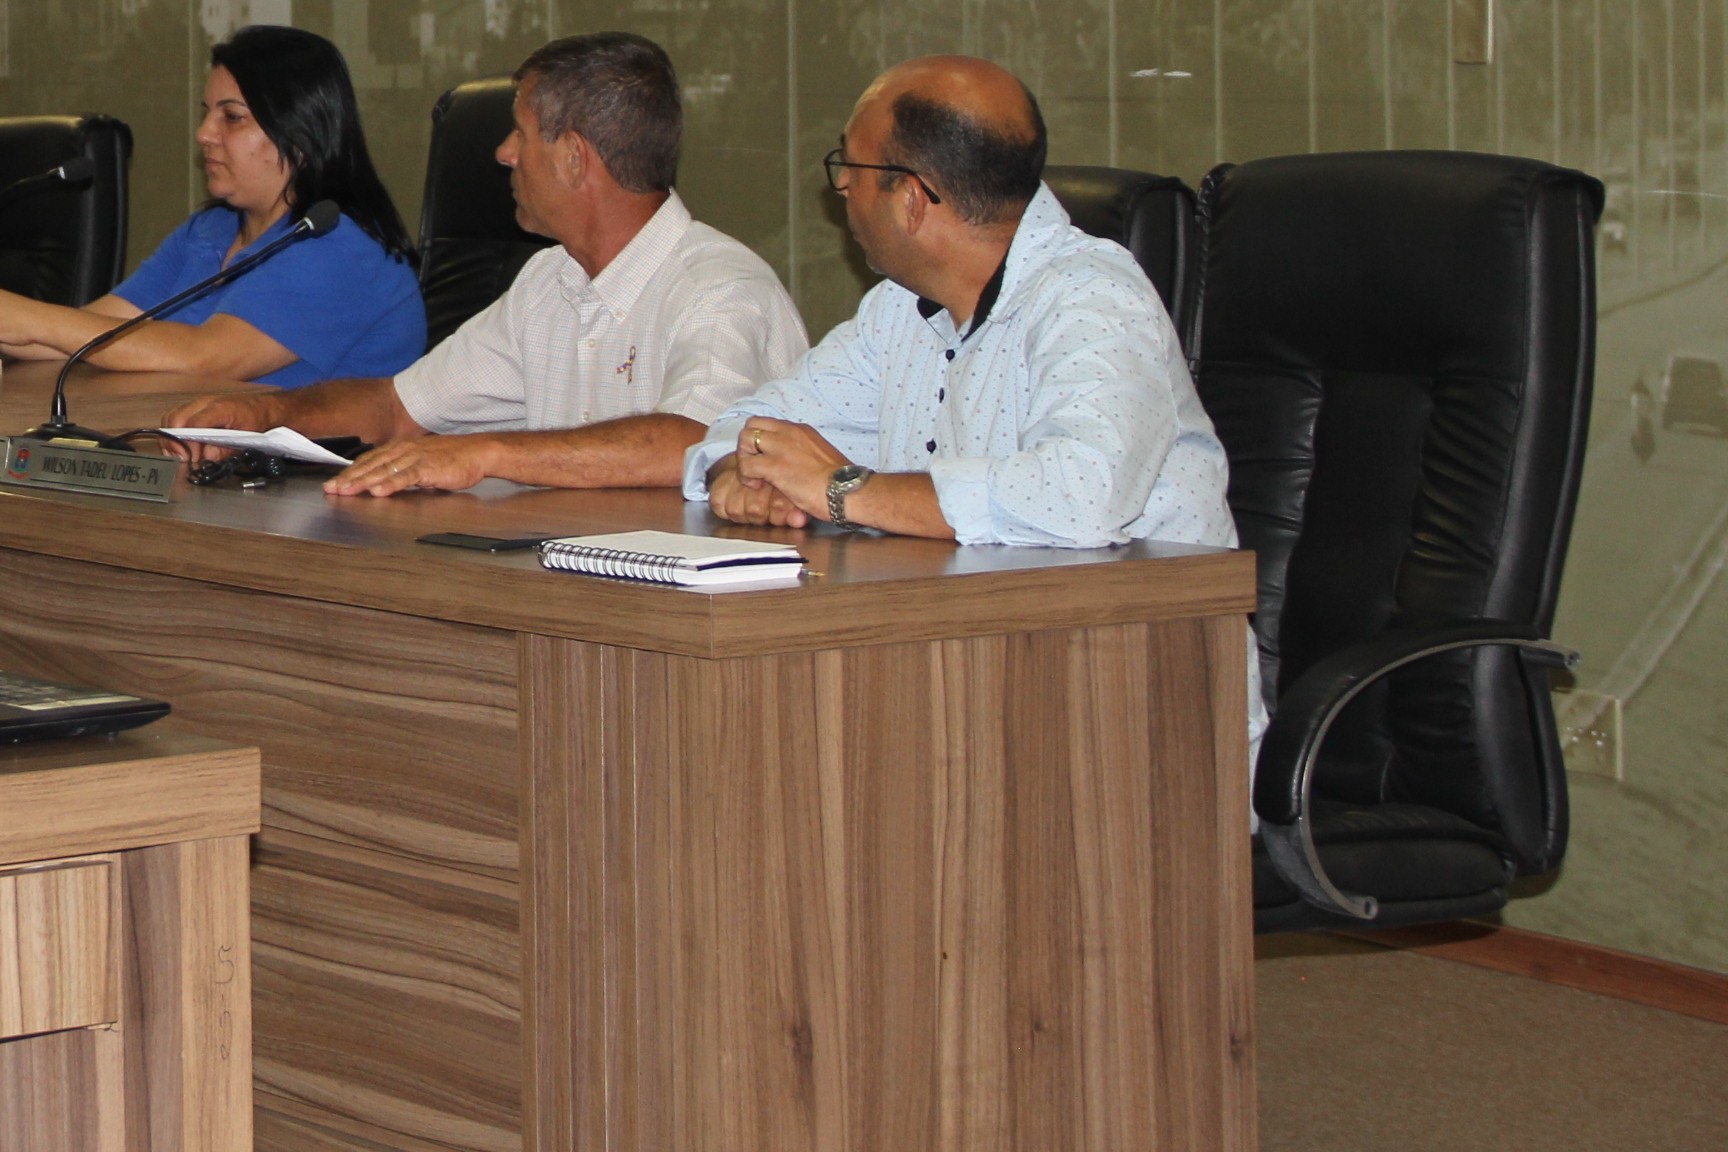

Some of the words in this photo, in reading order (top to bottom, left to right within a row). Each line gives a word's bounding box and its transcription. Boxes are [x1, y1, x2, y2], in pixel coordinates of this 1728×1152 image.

[42, 455, 77, 475] WILSON
[80, 459, 107, 480] TADEU
[110, 464, 142, 483] LOPES
